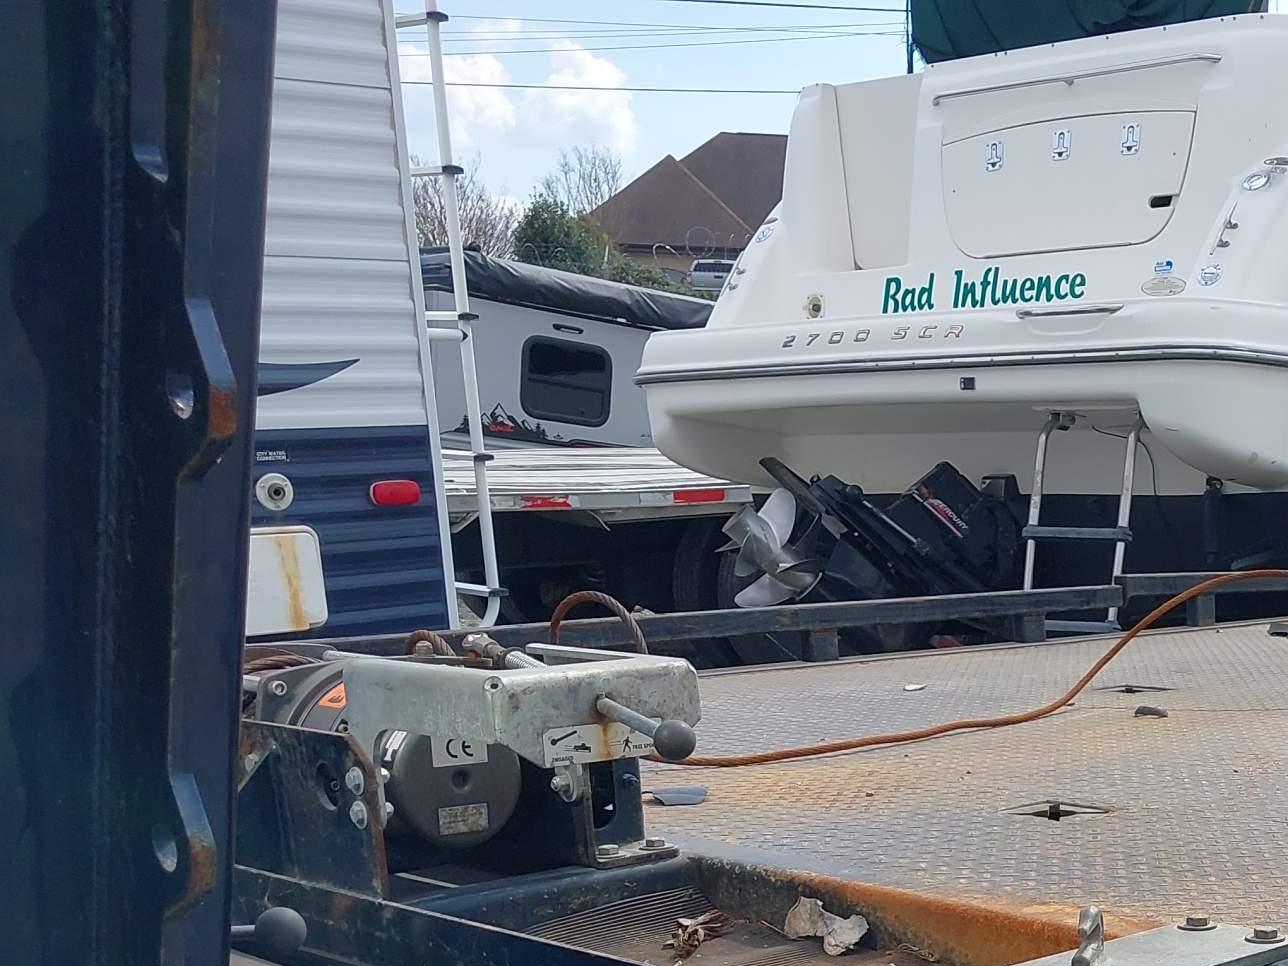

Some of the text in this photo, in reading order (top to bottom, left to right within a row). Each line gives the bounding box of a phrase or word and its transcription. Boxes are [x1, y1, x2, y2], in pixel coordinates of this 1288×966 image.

[881, 266, 1087, 315] Rad Influence
[782, 325, 964, 348] 2700 SCR
